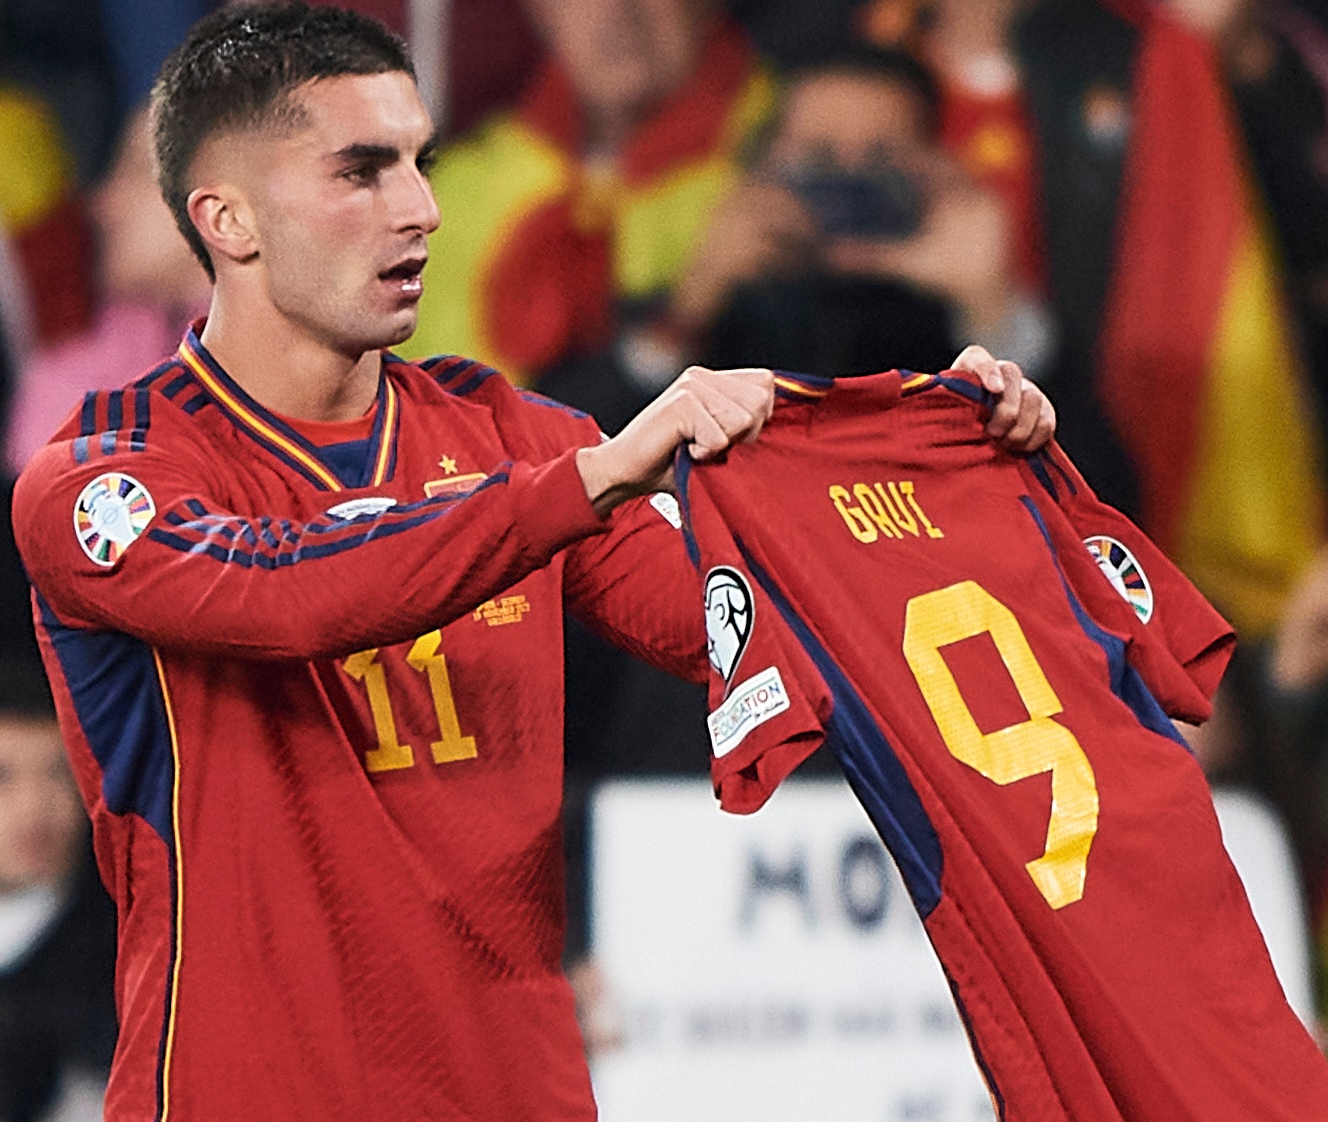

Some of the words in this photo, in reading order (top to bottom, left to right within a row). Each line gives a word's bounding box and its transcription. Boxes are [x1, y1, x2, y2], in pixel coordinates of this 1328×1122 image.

[343, 629, 478, 772] 11
[903, 579, 1099, 910] 9
[740, 832, 893, 935] MO
